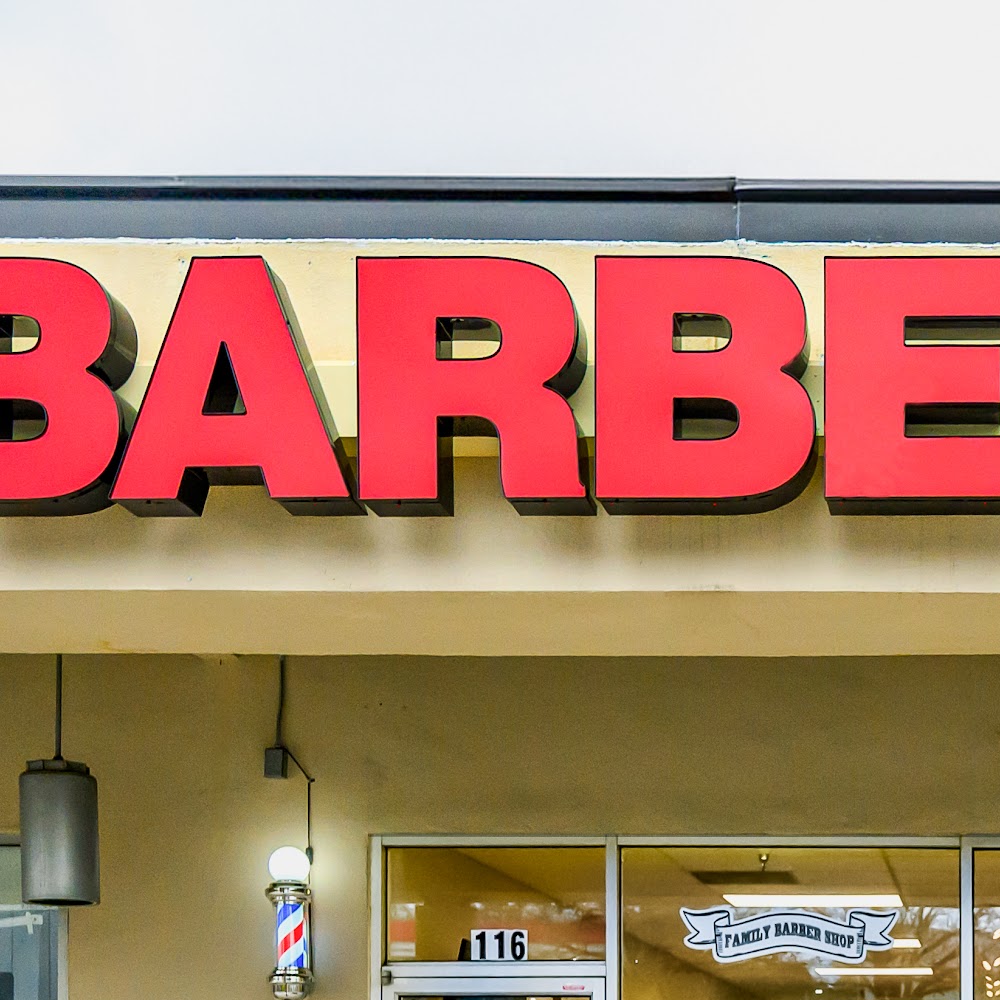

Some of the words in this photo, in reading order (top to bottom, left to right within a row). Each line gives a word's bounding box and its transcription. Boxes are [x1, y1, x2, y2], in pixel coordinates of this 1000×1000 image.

[475, 930, 526, 960] 116
[724, 925, 772, 948] FAMILY
[774, 922, 821, 942] BARBER
[824, 929, 855, 949] SHOP
